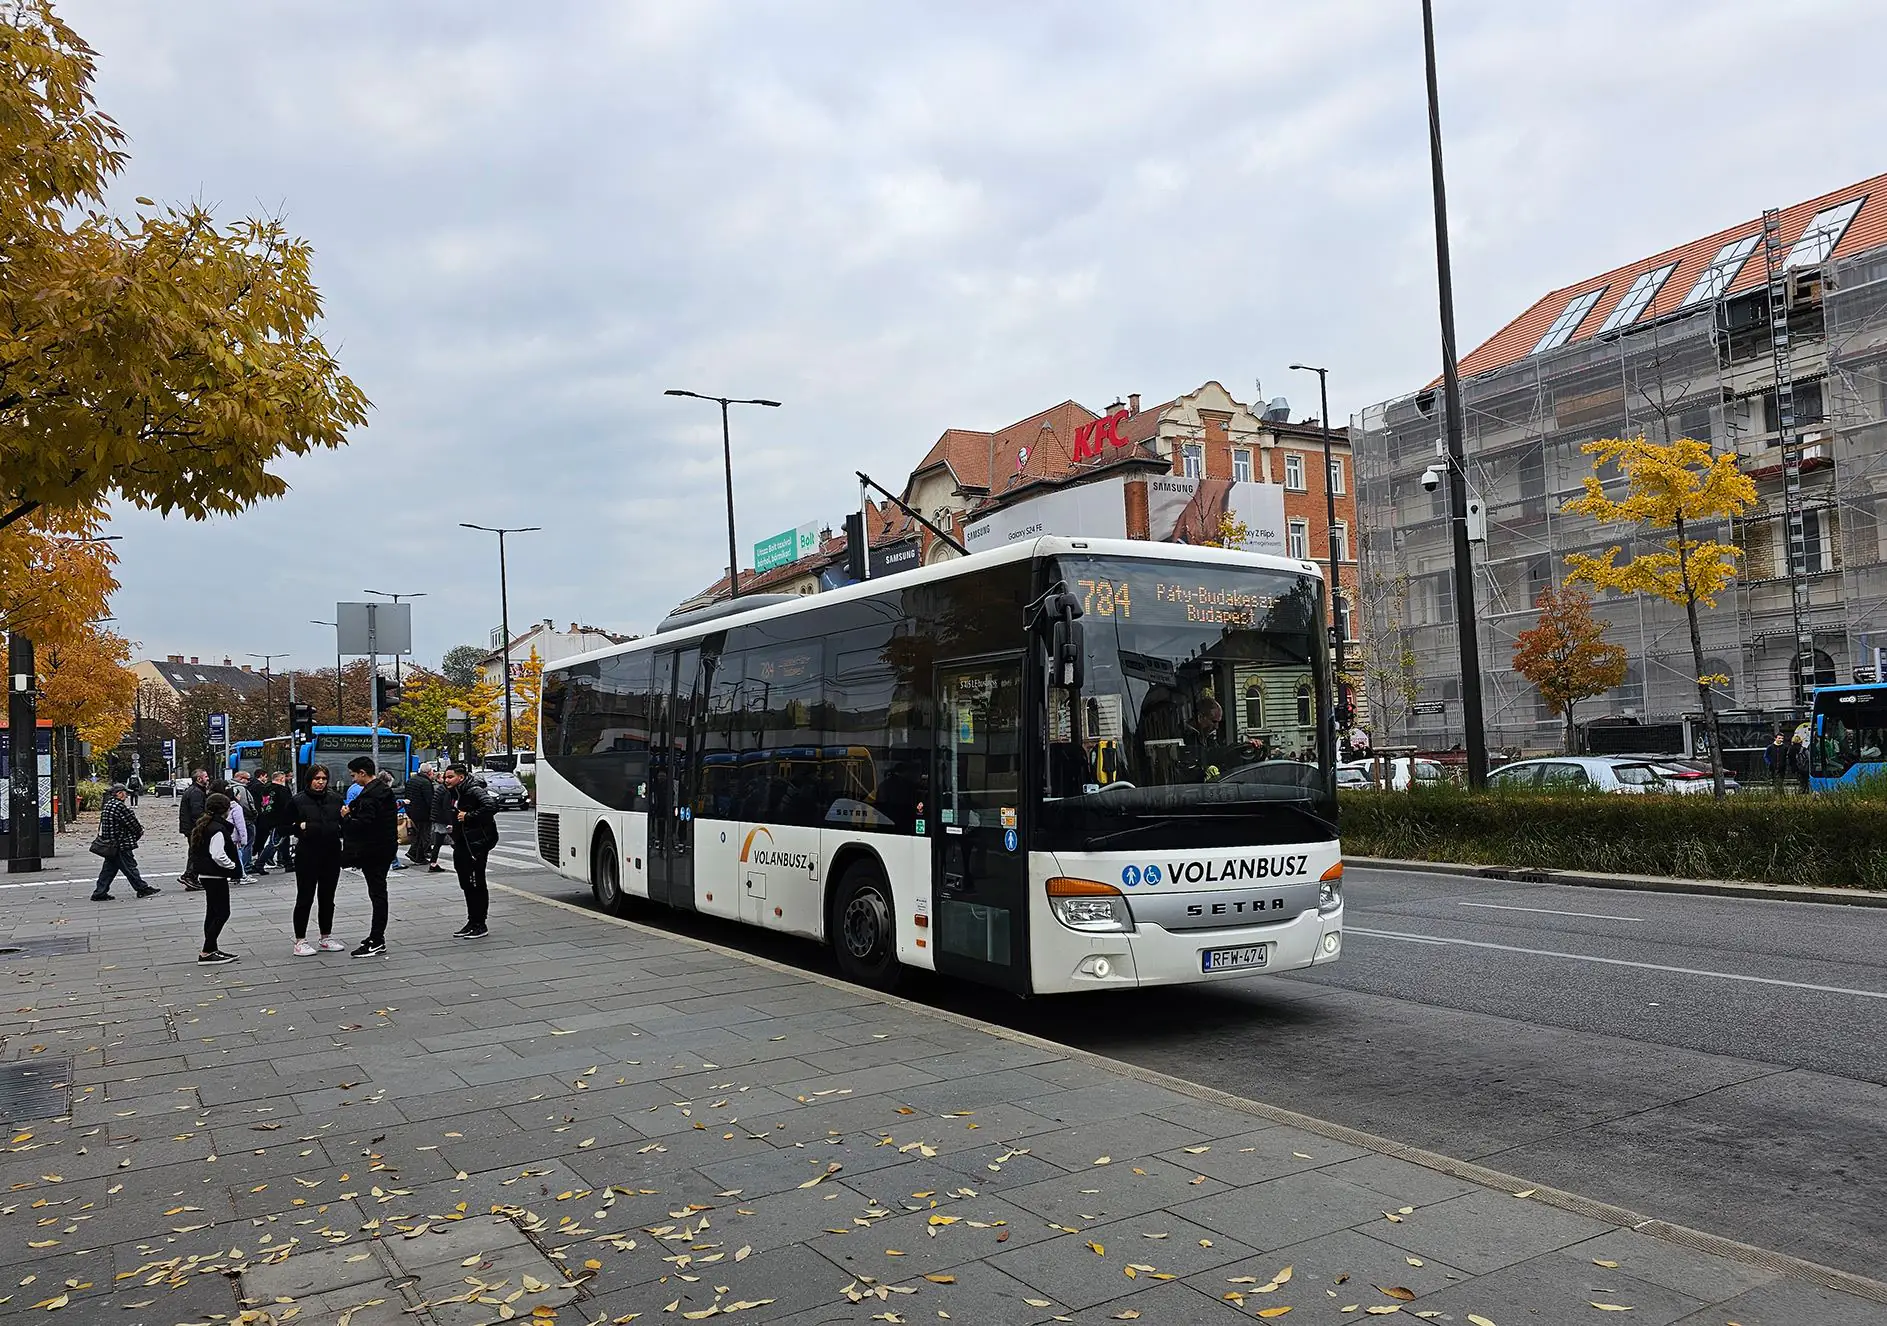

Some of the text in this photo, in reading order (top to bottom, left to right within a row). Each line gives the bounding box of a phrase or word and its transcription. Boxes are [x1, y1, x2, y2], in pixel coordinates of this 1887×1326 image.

[1072, 409, 1129, 463] KFC
[1153, 482, 1194, 493] SAMSUNG
[800, 532, 815, 548] Bolt
[967, 524, 990, 542] SAMSUNG
[1007, 523, 1042, 541] Galaxy S24 FE
[885, 549, 916, 565] SAMSUNG
[1077, 579, 1131, 618] 784
[1186, 604, 1256, 626] Budapest
[836, 808, 868, 817] SETRA
[754, 850, 808, 869] VOLÁNBUSZ
[1167, 855, 1308, 885] VOLÁNBUSZ
[1187, 898, 1284, 917] SETRA
[1212, 950, 1264, 967] RFW-474
